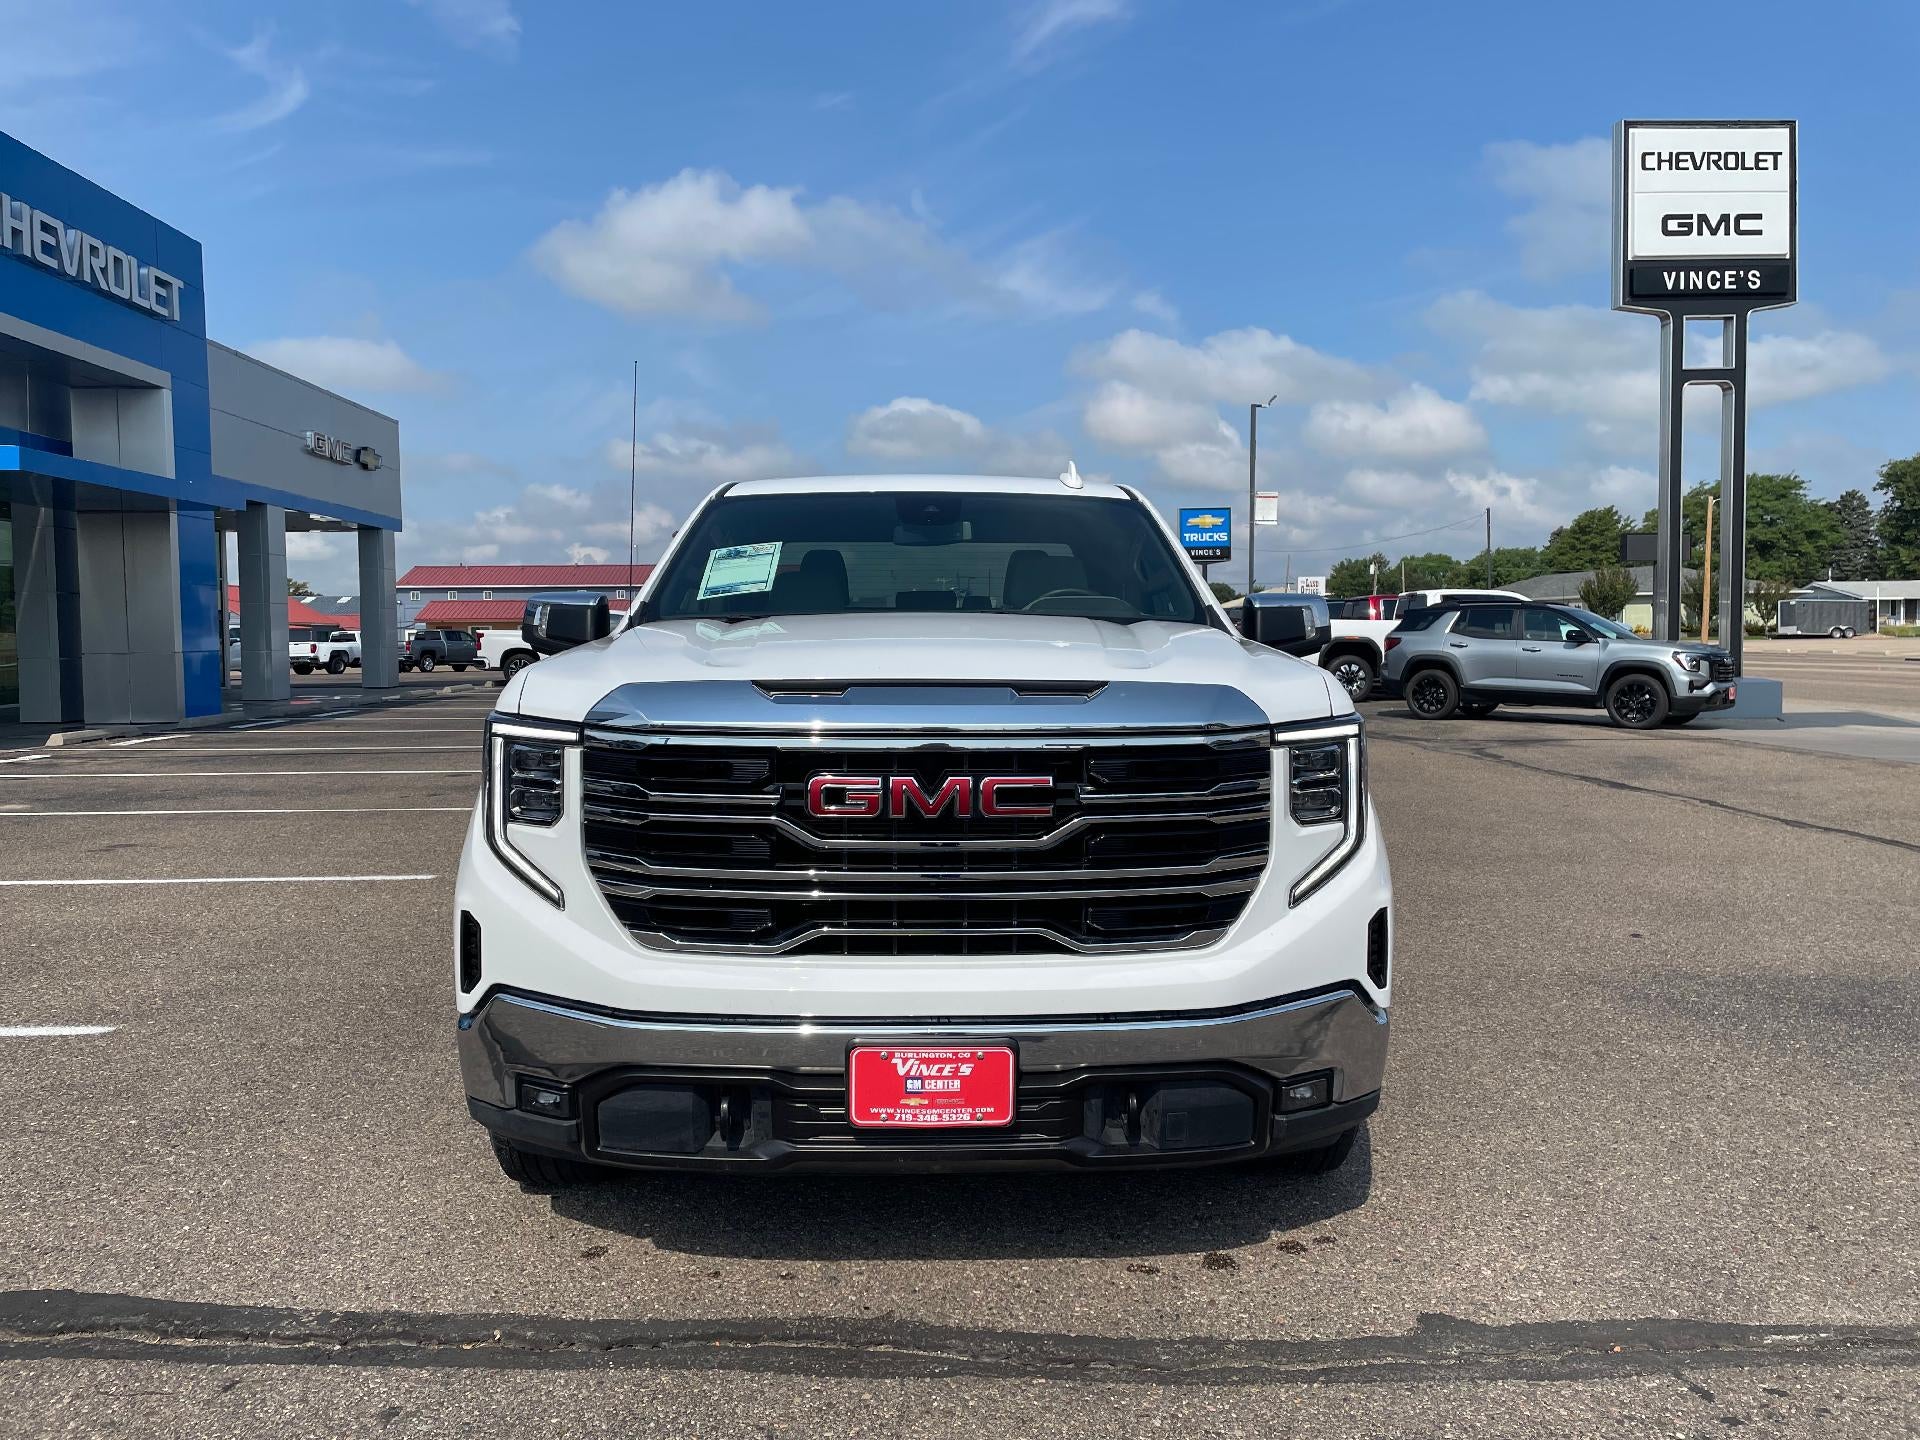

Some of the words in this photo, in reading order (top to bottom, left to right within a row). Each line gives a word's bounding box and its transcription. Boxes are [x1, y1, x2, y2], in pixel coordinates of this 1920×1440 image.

[1641, 151, 1783, 171] CHEVROLET
[1661, 213, 1763, 236] GMC
[0, 192, 184, 322] HEVROLET
[1663, 270, 1761, 290] VINCE'S
[306, 431, 354, 466] GMC
[1183, 532, 1228, 542] TRUCKS
[1190, 548, 1221, 556] VINCE'S
[807, 775, 1054, 818] GMC
[906, 1079, 922, 1090] GM
[924, 1079, 961, 1090] CENTER
[894, 1113, 971, 1122] 719-346-5326
